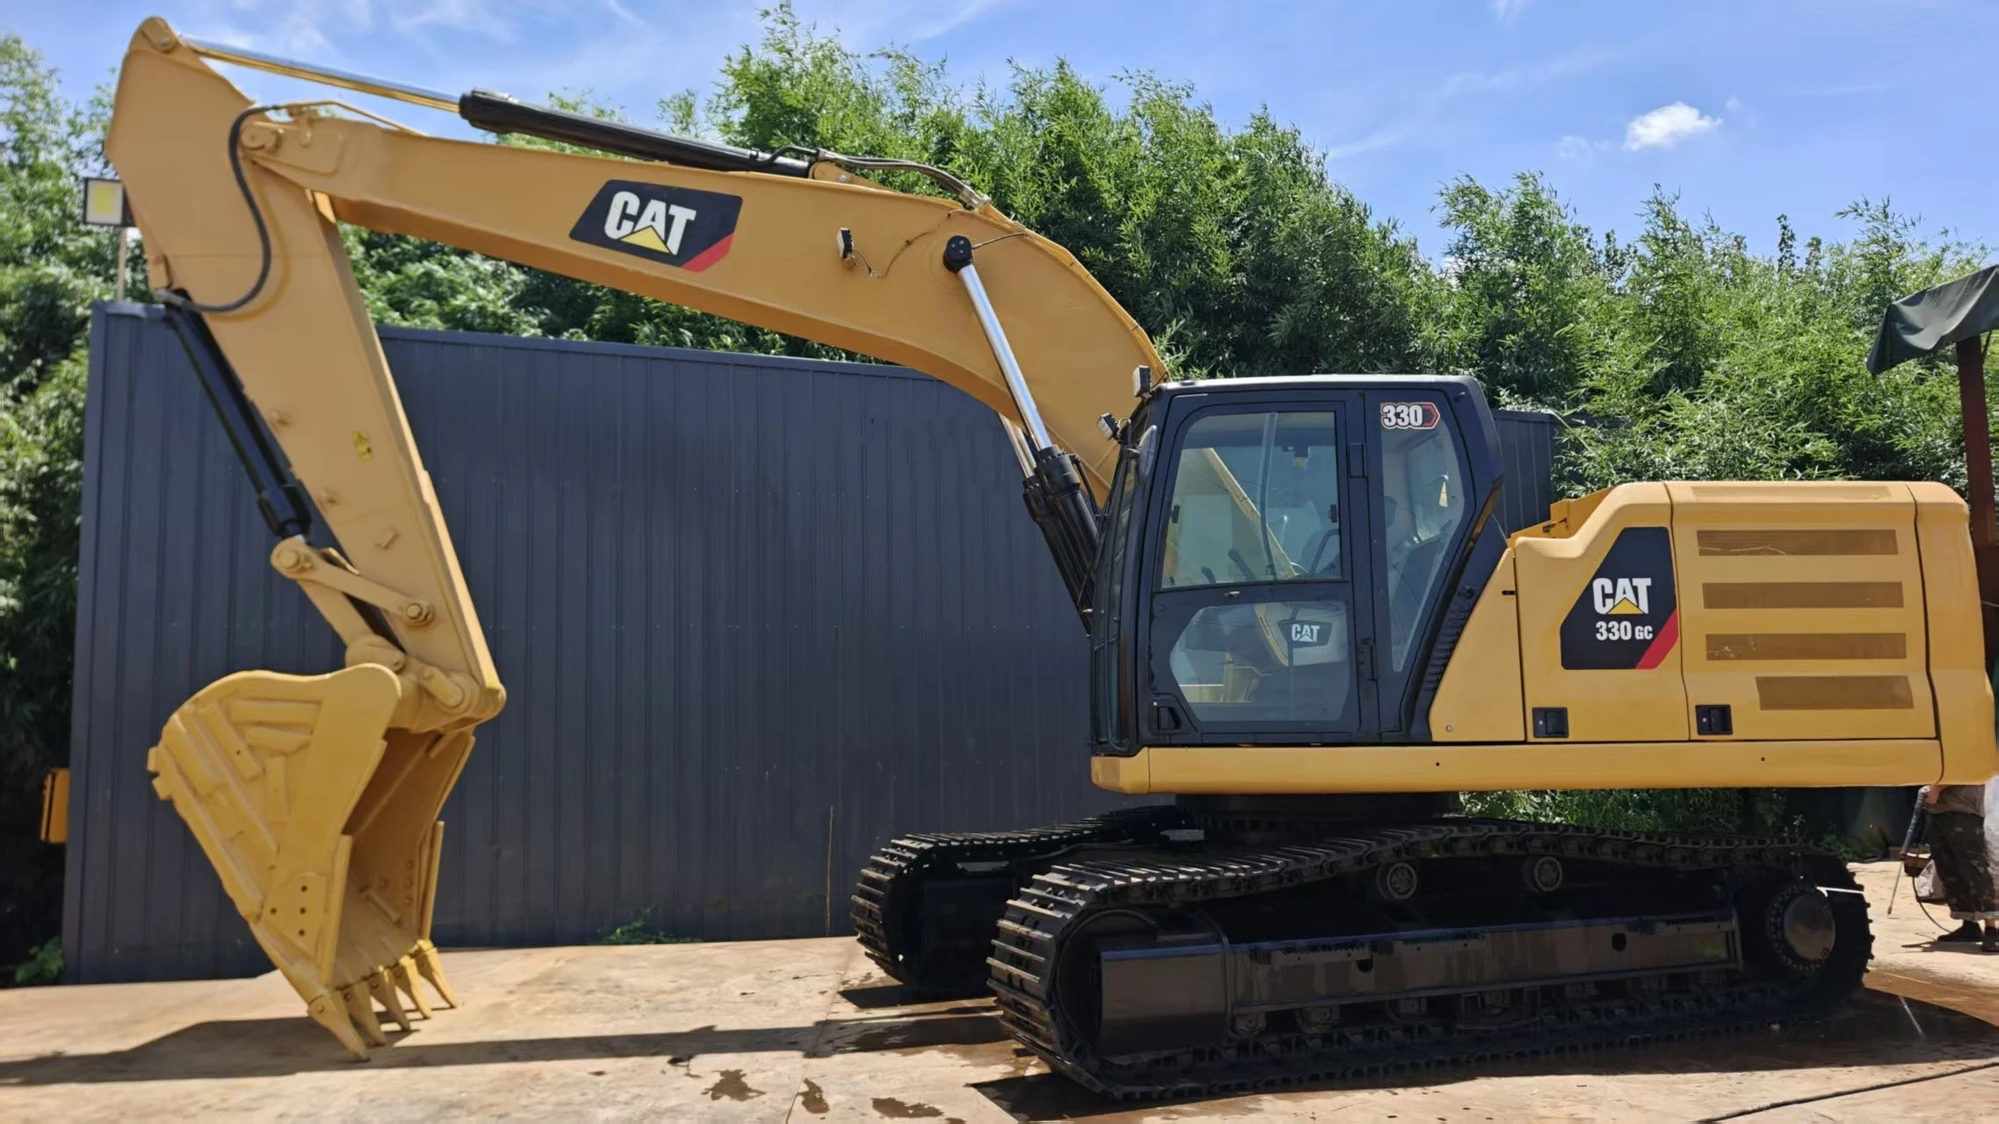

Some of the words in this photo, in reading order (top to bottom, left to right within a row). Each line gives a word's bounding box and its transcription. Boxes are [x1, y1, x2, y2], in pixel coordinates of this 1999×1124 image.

[604, 190, 697, 256] CAT
[1382, 404, 1423, 427] 330
[1592, 577, 1652, 615] CAT
[1291, 623, 1320, 642] CAT
[1595, 621, 1632, 641] 330
[1634, 625, 1653, 640] GC
